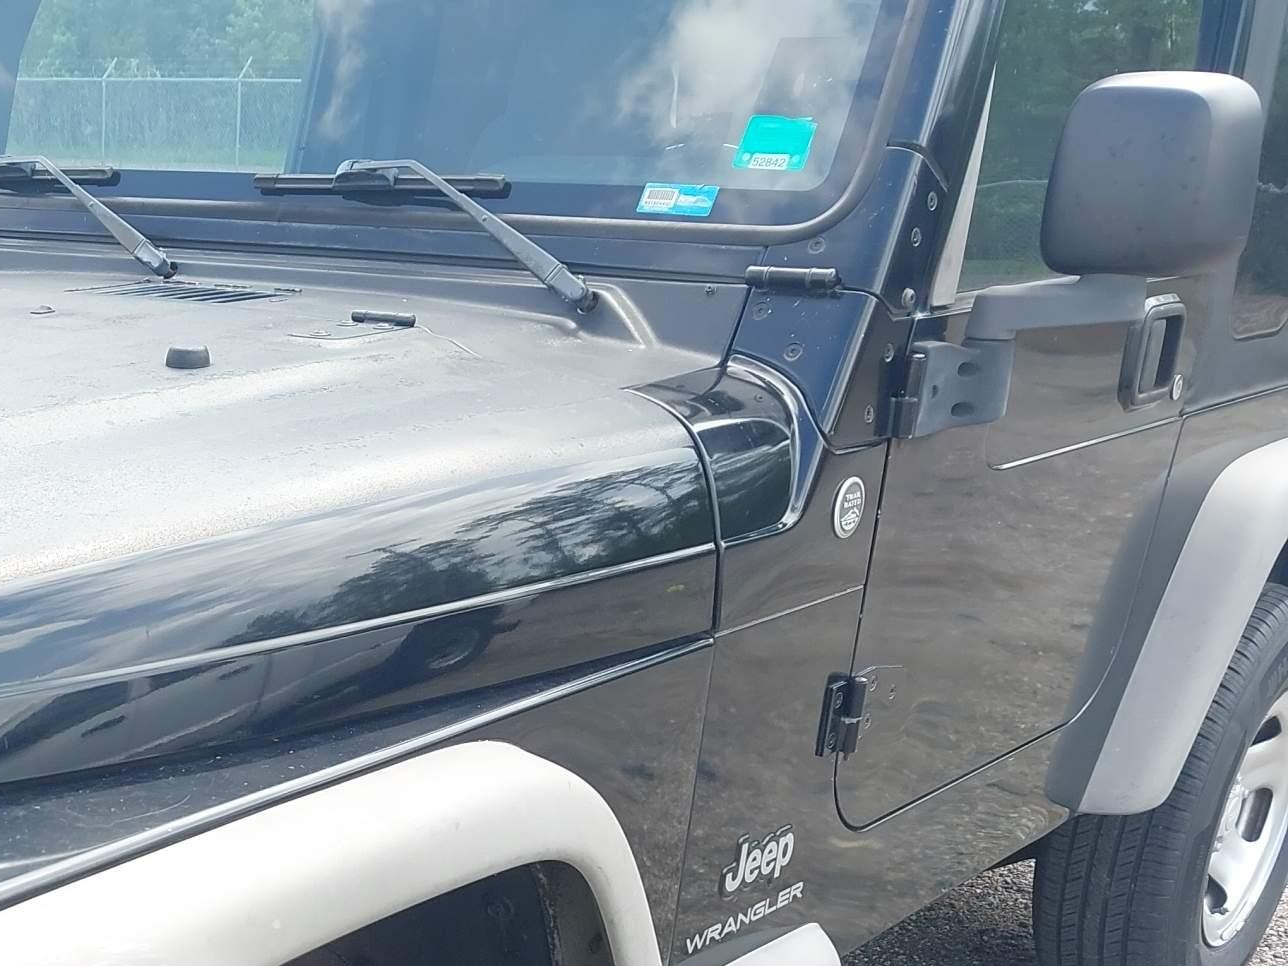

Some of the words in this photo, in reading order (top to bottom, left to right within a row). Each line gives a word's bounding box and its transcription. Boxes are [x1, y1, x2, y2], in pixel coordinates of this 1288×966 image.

[752, 157, 786, 168] 52842
[723, 829, 795, 893] Jeep
[685, 880, 805, 955] WRANGLER
